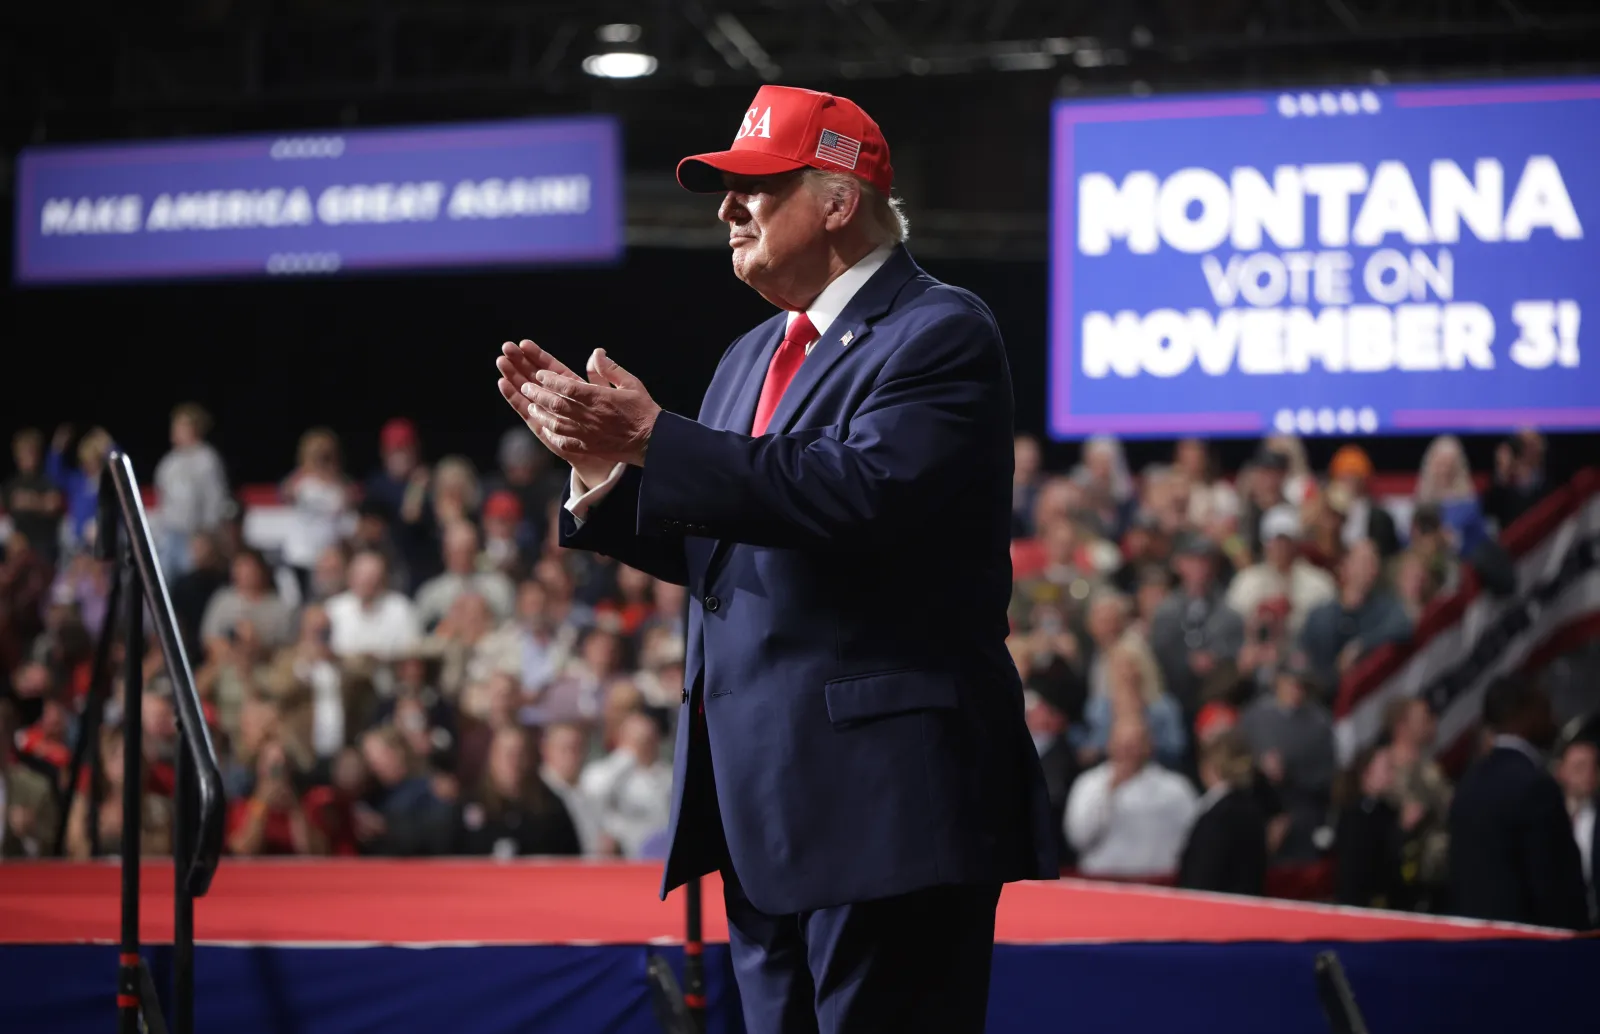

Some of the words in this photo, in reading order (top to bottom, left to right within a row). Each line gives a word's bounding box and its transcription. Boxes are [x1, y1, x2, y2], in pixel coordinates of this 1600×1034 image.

[41, 195, 141, 235] MAKE
[147, 187, 314, 231] AMERICA
[317, 180, 444, 226] GREAT
[448, 174, 590, 220] AGAIN!
[1077, 154, 1583, 256] MONTANA
[1202, 250, 1355, 307] VOTE
[1363, 247, 1454, 304] ON
[1081, 301, 1495, 378] NOVEMBER
[1509, 299, 1581, 369] 3!
